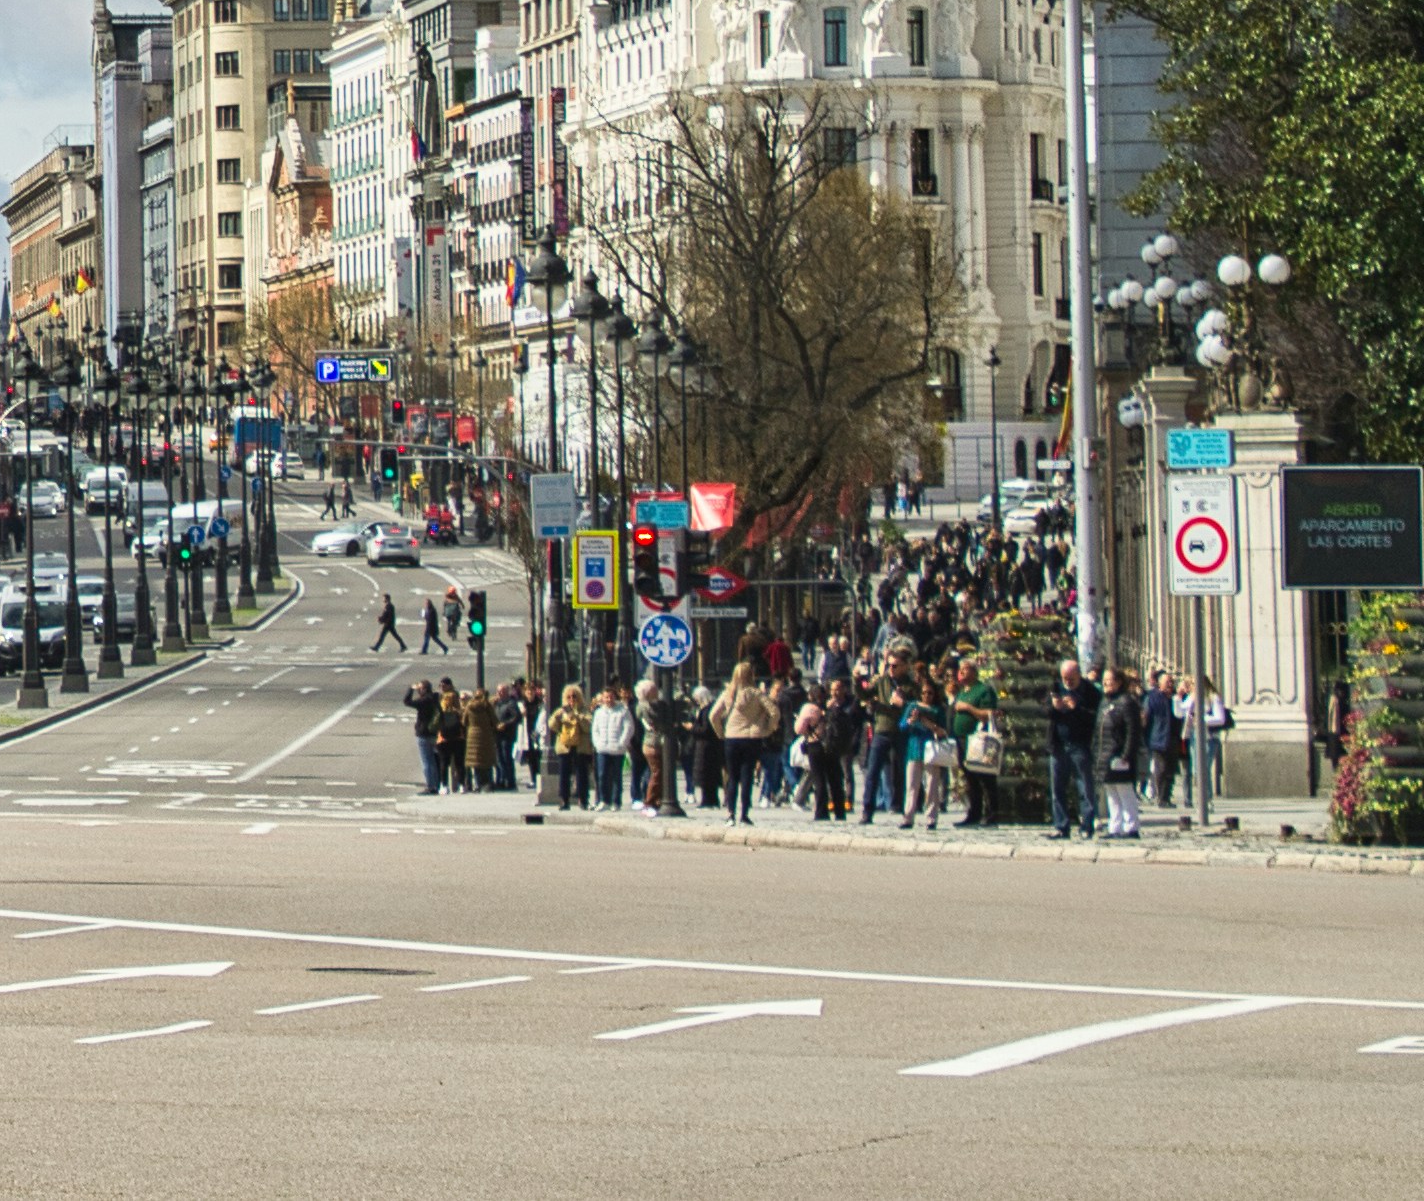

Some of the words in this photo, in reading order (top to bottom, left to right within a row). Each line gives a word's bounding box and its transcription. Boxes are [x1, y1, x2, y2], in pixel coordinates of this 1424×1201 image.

[523, 134, 533, 191] MUJERES
[432, 254, 442, 265] 31
[1323, 503, 1382, 515] ABIERTO
[1299, 519, 1406, 531] APARCAMIENTO
[1308, 536, 1334, 548] LAS
[1337, 536, 1393, 548] CORTES
